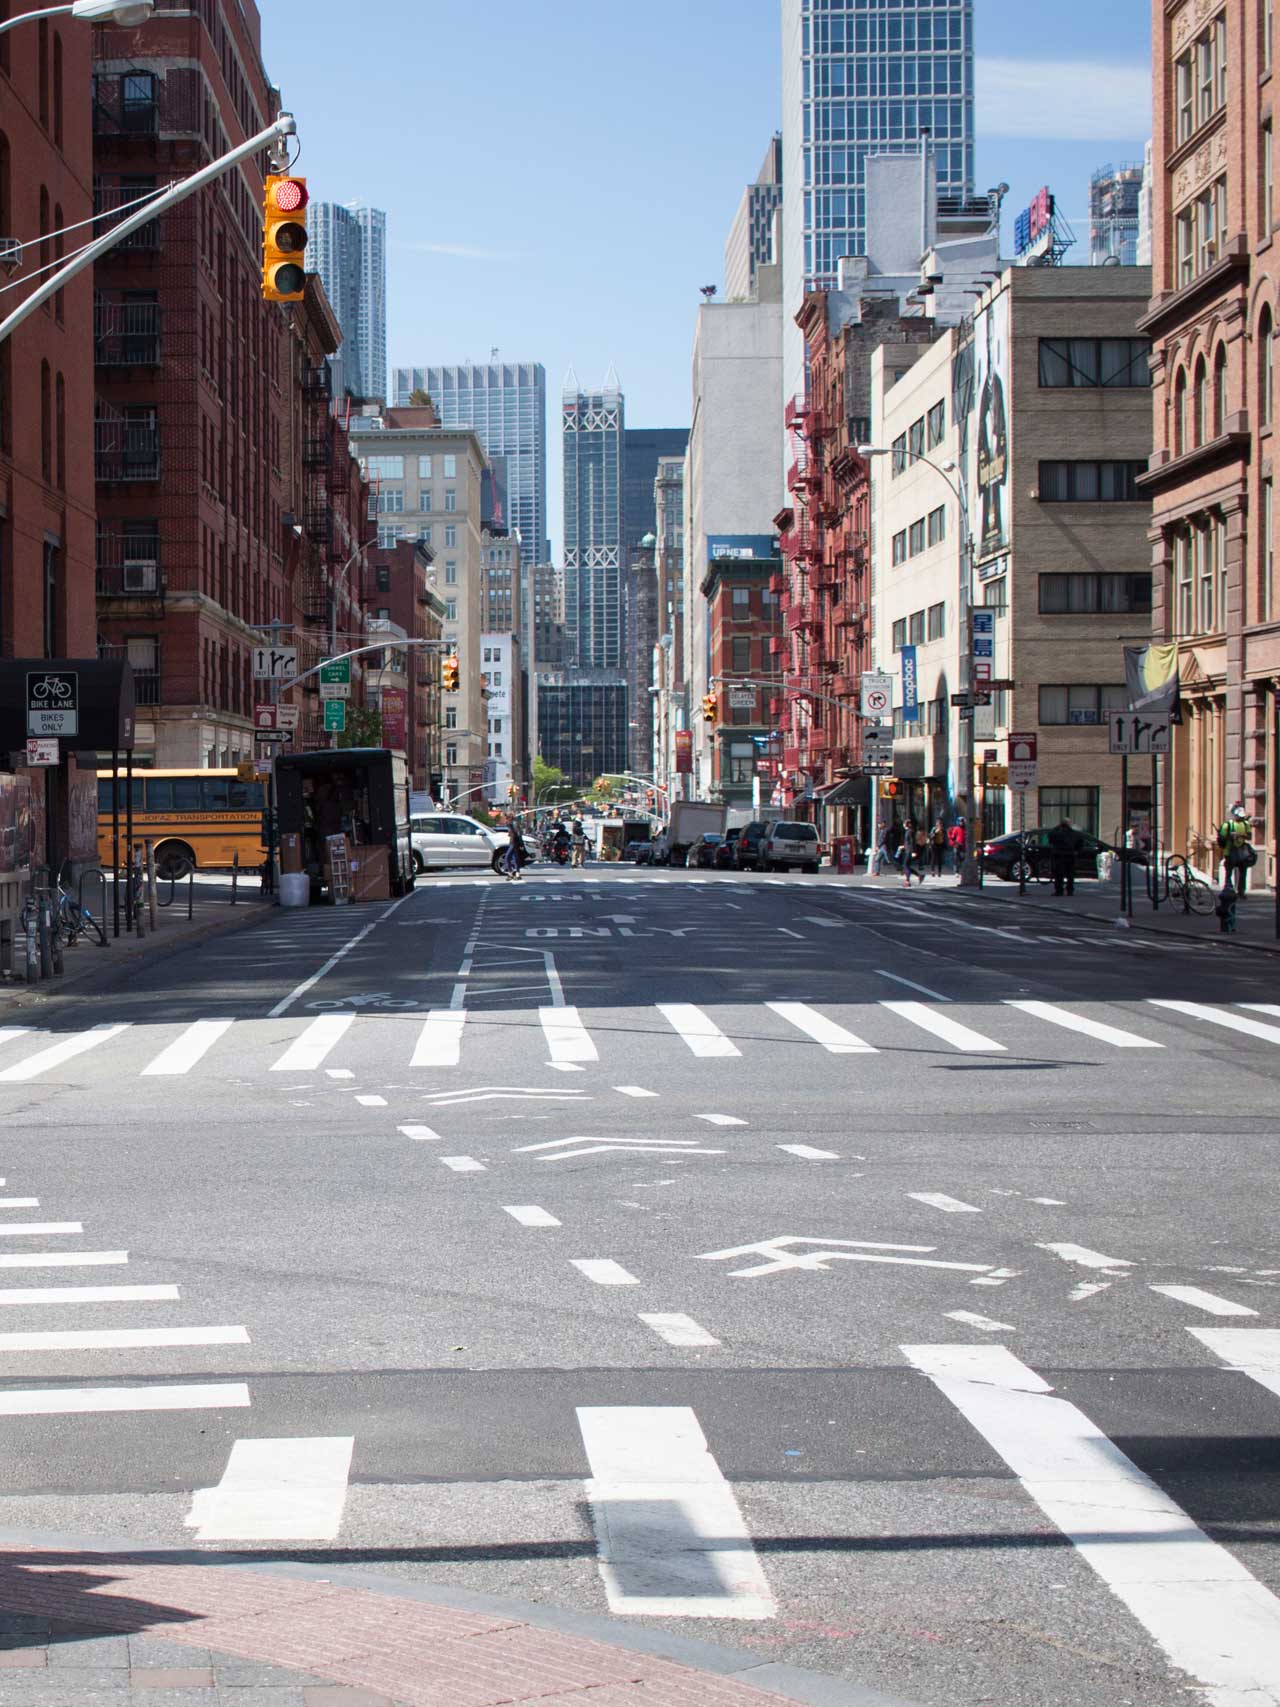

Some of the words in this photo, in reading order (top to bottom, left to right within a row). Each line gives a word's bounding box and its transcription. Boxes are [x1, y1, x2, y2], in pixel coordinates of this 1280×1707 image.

[31, 700, 49, 709] BIKE
[52, 700, 74, 708] LANE
[40, 714, 65, 722] BIKES
[42, 723, 63, 731] ONLY
[175, 813, 257, 821] TRANSPORTATION
[524, 927, 698, 937] ONLY
